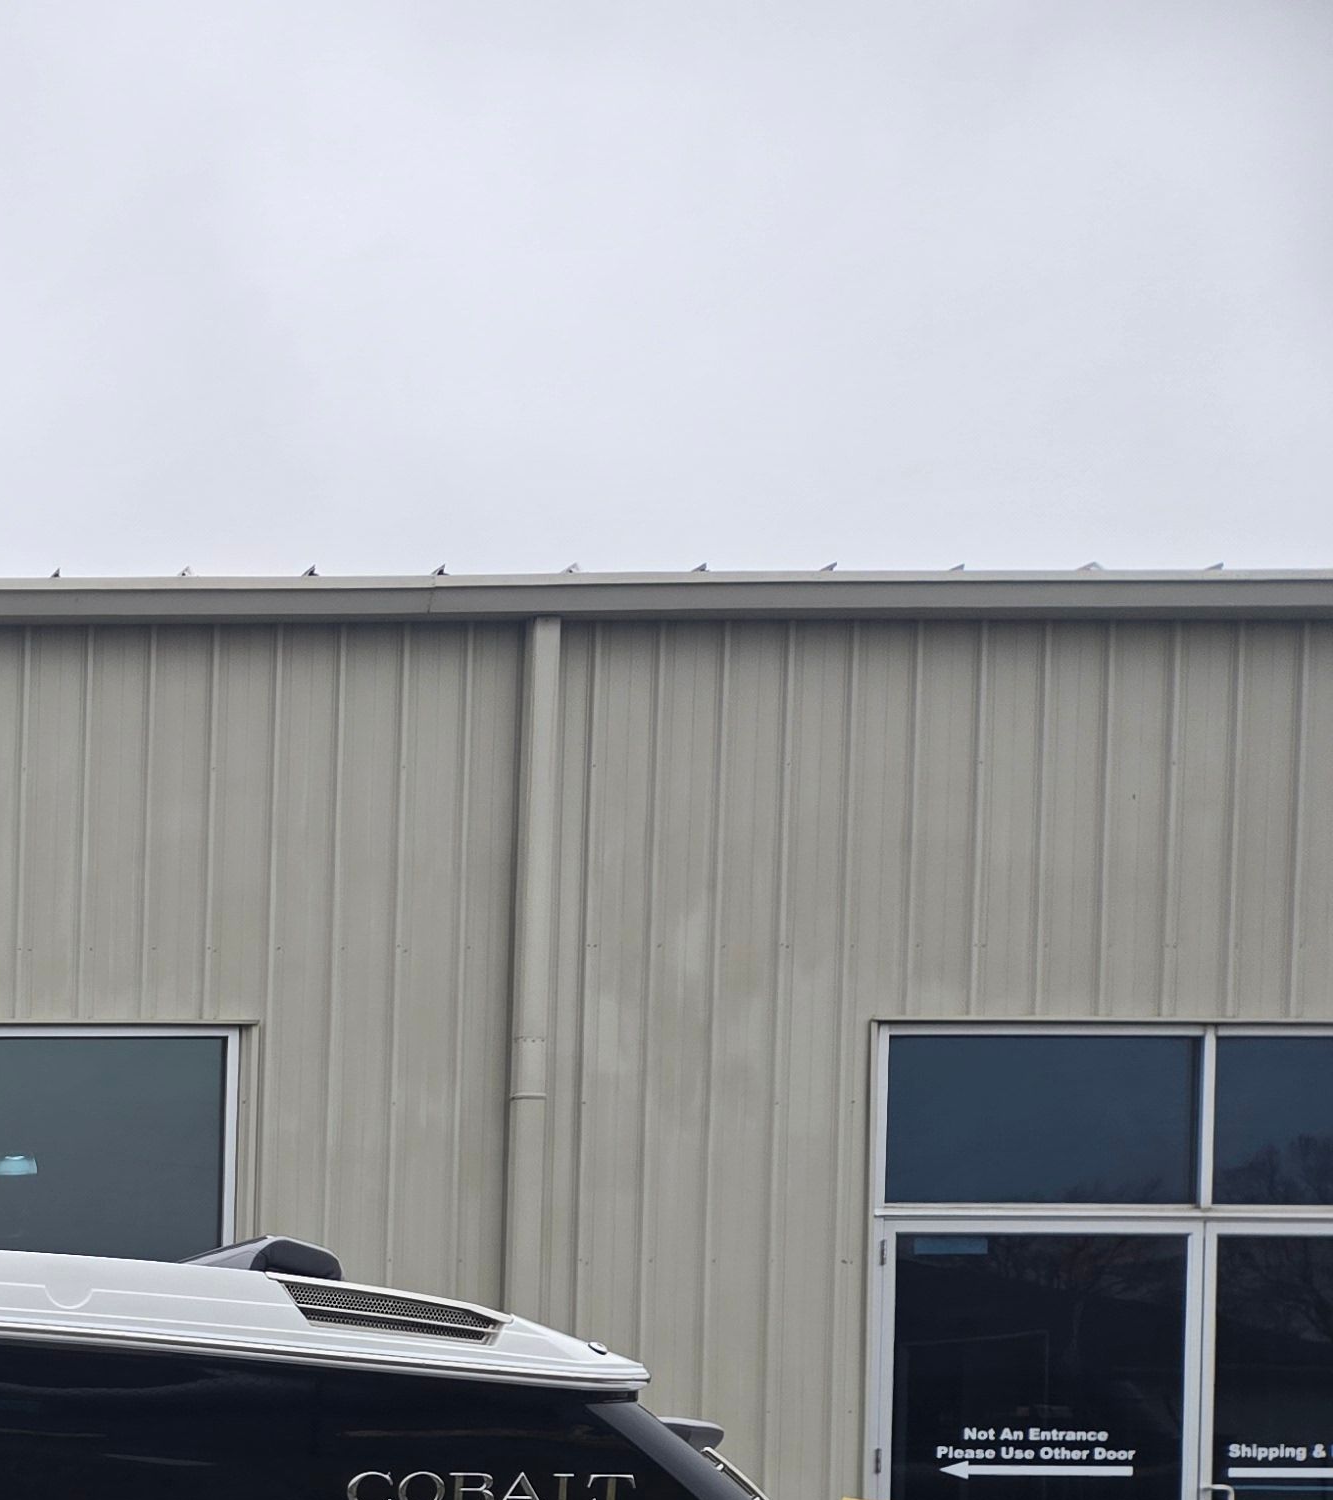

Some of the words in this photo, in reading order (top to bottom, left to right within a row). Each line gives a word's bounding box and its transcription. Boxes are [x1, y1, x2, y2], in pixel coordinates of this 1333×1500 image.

[963, 1427, 996, 1441] Not
[999, 1427, 1024, 1441] An
[1028, 1427, 1109, 1442] Entrance
[936, 1445, 996, 1460] Please
[1000, 1446, 1035, 1460] Use
[1039, 1446, 1090, 1460] Other
[1093, 1446, 1136, 1461] Door
[1228, 1443, 1308, 1462] Shipping
[1311, 1443, 1327, 1459] &
